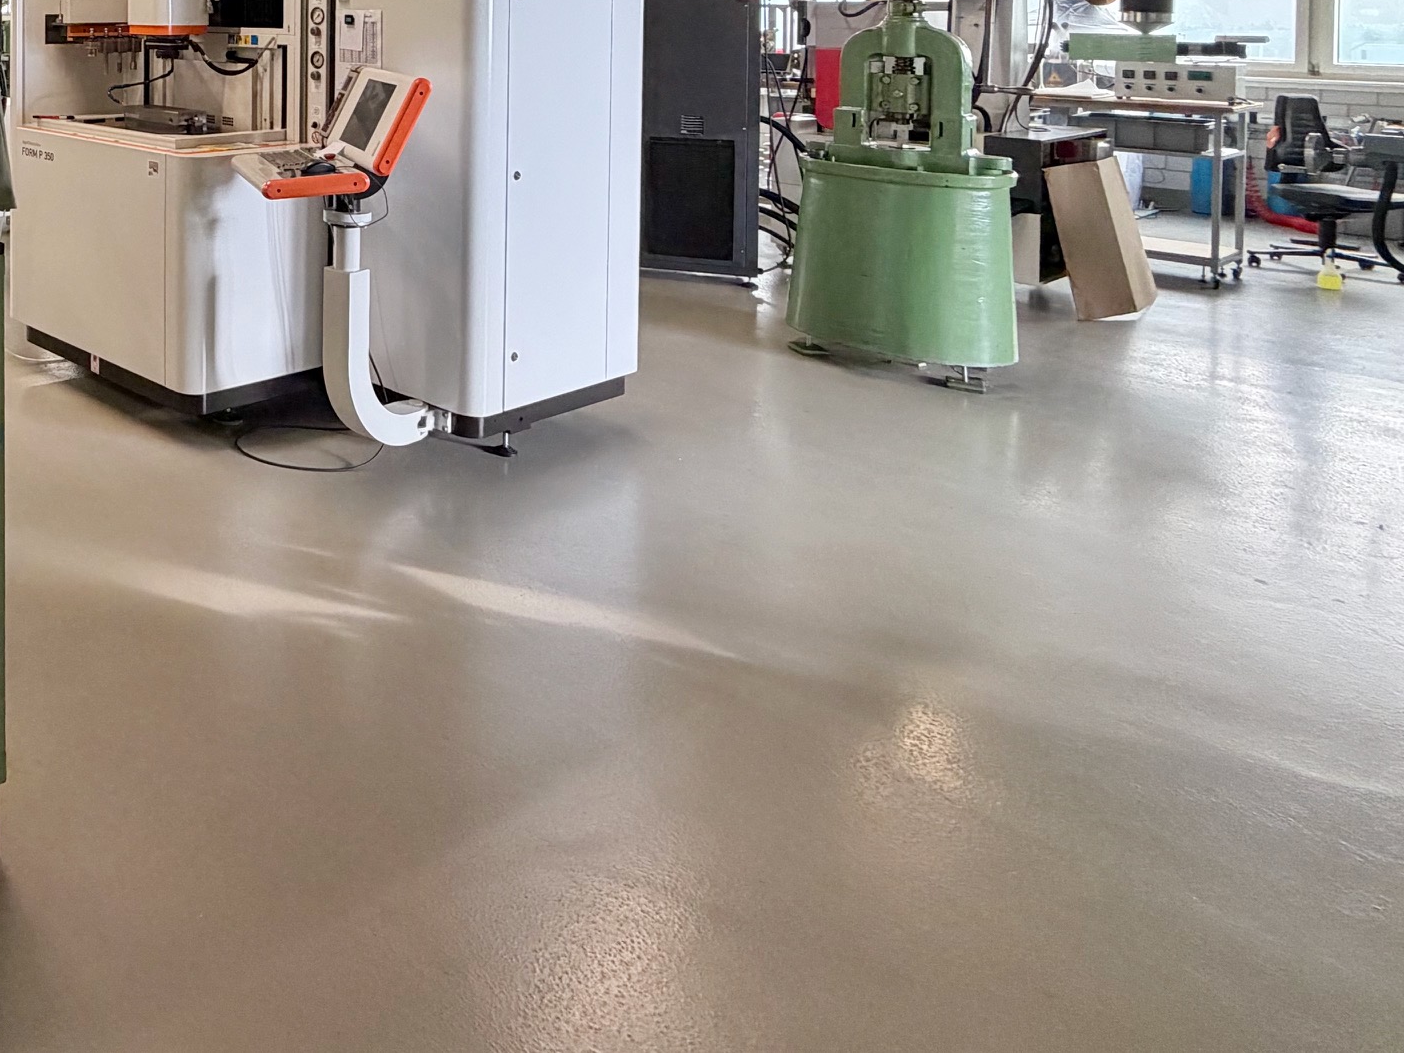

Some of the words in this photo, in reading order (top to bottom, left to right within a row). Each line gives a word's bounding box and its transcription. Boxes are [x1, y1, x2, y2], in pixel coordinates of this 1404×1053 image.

[21, 146, 38, 158] FORM
[38, 149, 44, 159] P
[44, 151, 55, 161] 350
